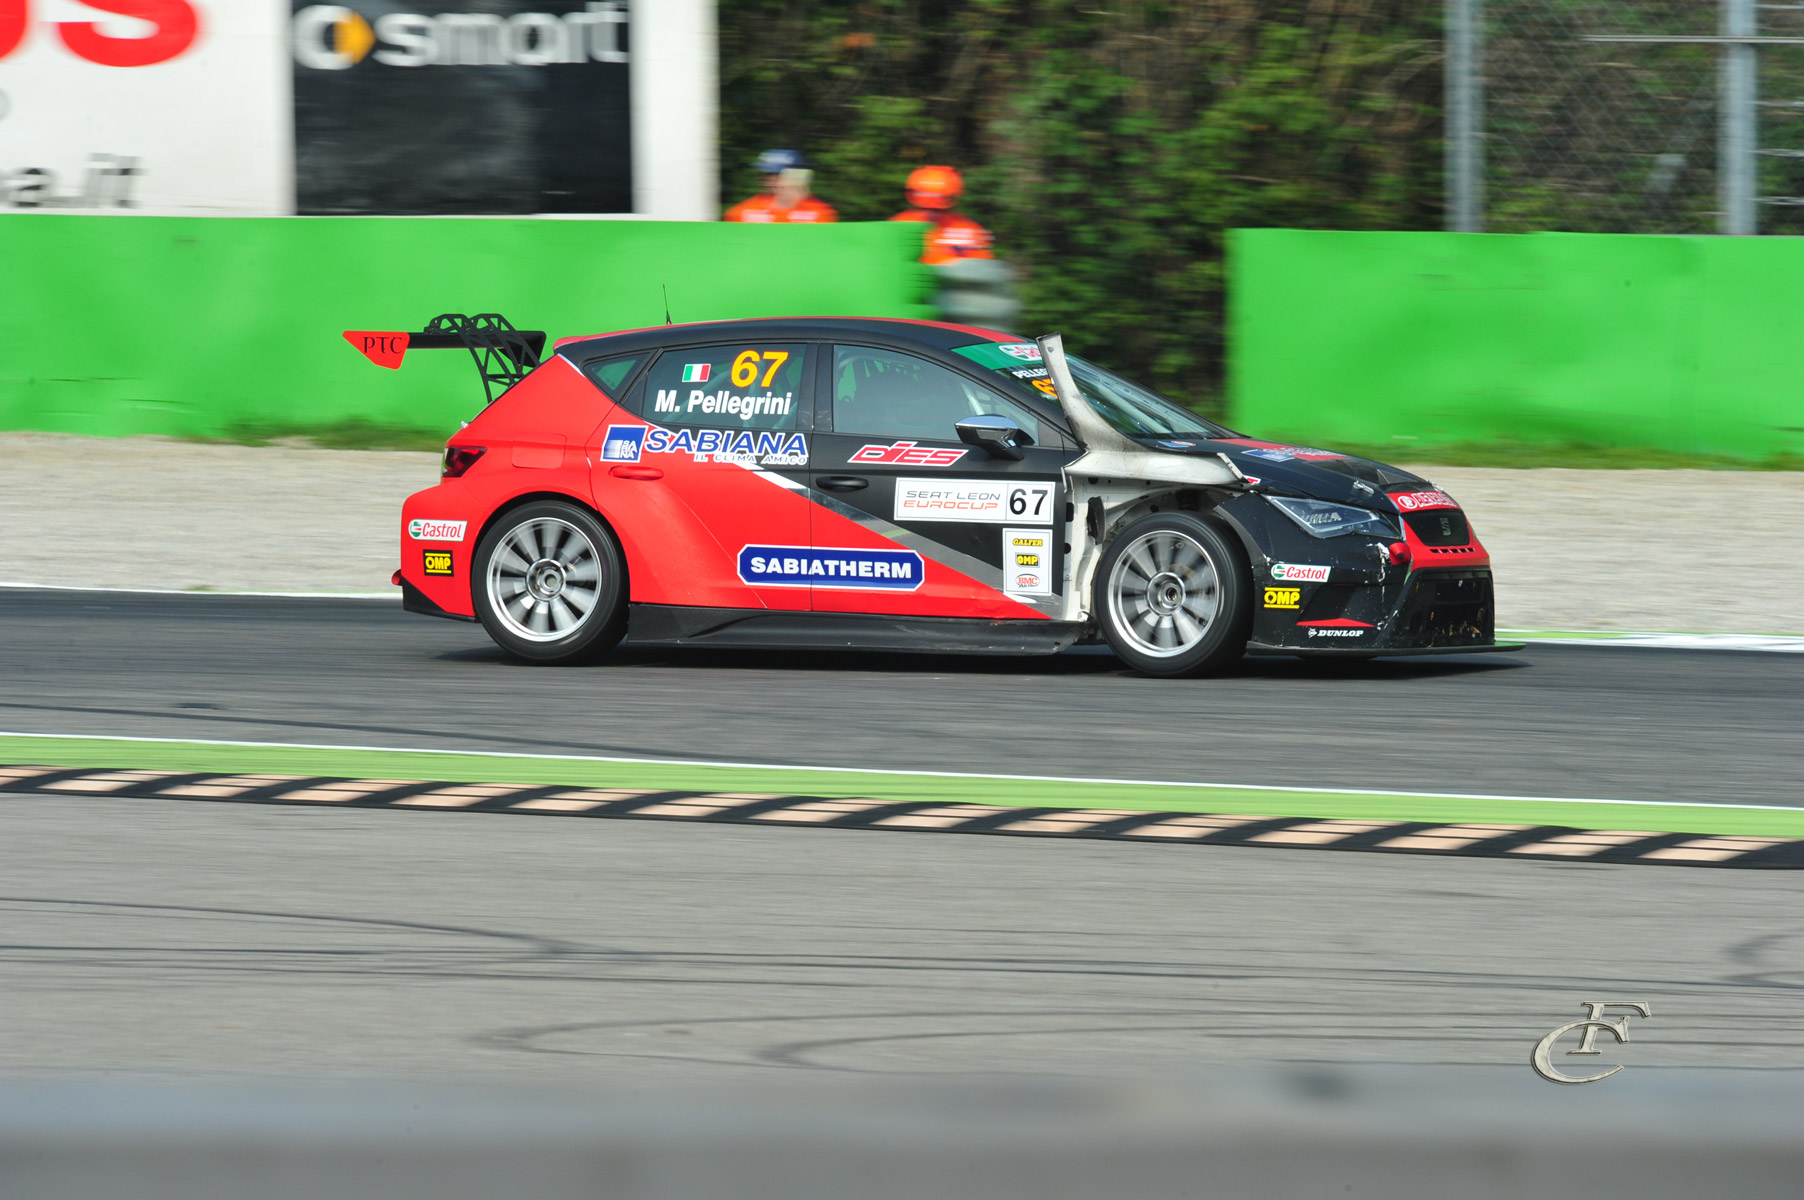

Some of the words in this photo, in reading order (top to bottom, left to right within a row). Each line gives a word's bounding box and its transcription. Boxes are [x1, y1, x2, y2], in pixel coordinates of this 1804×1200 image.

[363, 336, 403, 354] PTC
[730, 350, 789, 388] 67
[655, 389, 681, 412] M.
[687, 390, 792, 420] Pellegrini
[645, 428, 809, 457] SABIANA
[696, 454, 708, 462] IL
[715, 454, 755, 463] CLIMA
[763, 456, 806, 464] AMICO
[906, 491, 953, 499] SEAT
[957, 492, 1001, 500] LEON
[1009, 488, 1049, 515] 67
[903, 500, 998, 510] EUROCUP
[422, 522, 462, 538] Castrol
[425, 556, 451, 569] OMP
[750, 556, 912, 578] SABIATHERM
[1017, 555, 1039, 565] OMP
[1286, 566, 1327, 580] Castrol
[1264, 591, 1300, 605] OMP
[1317, 629, 1364, 637] DUNLOP
